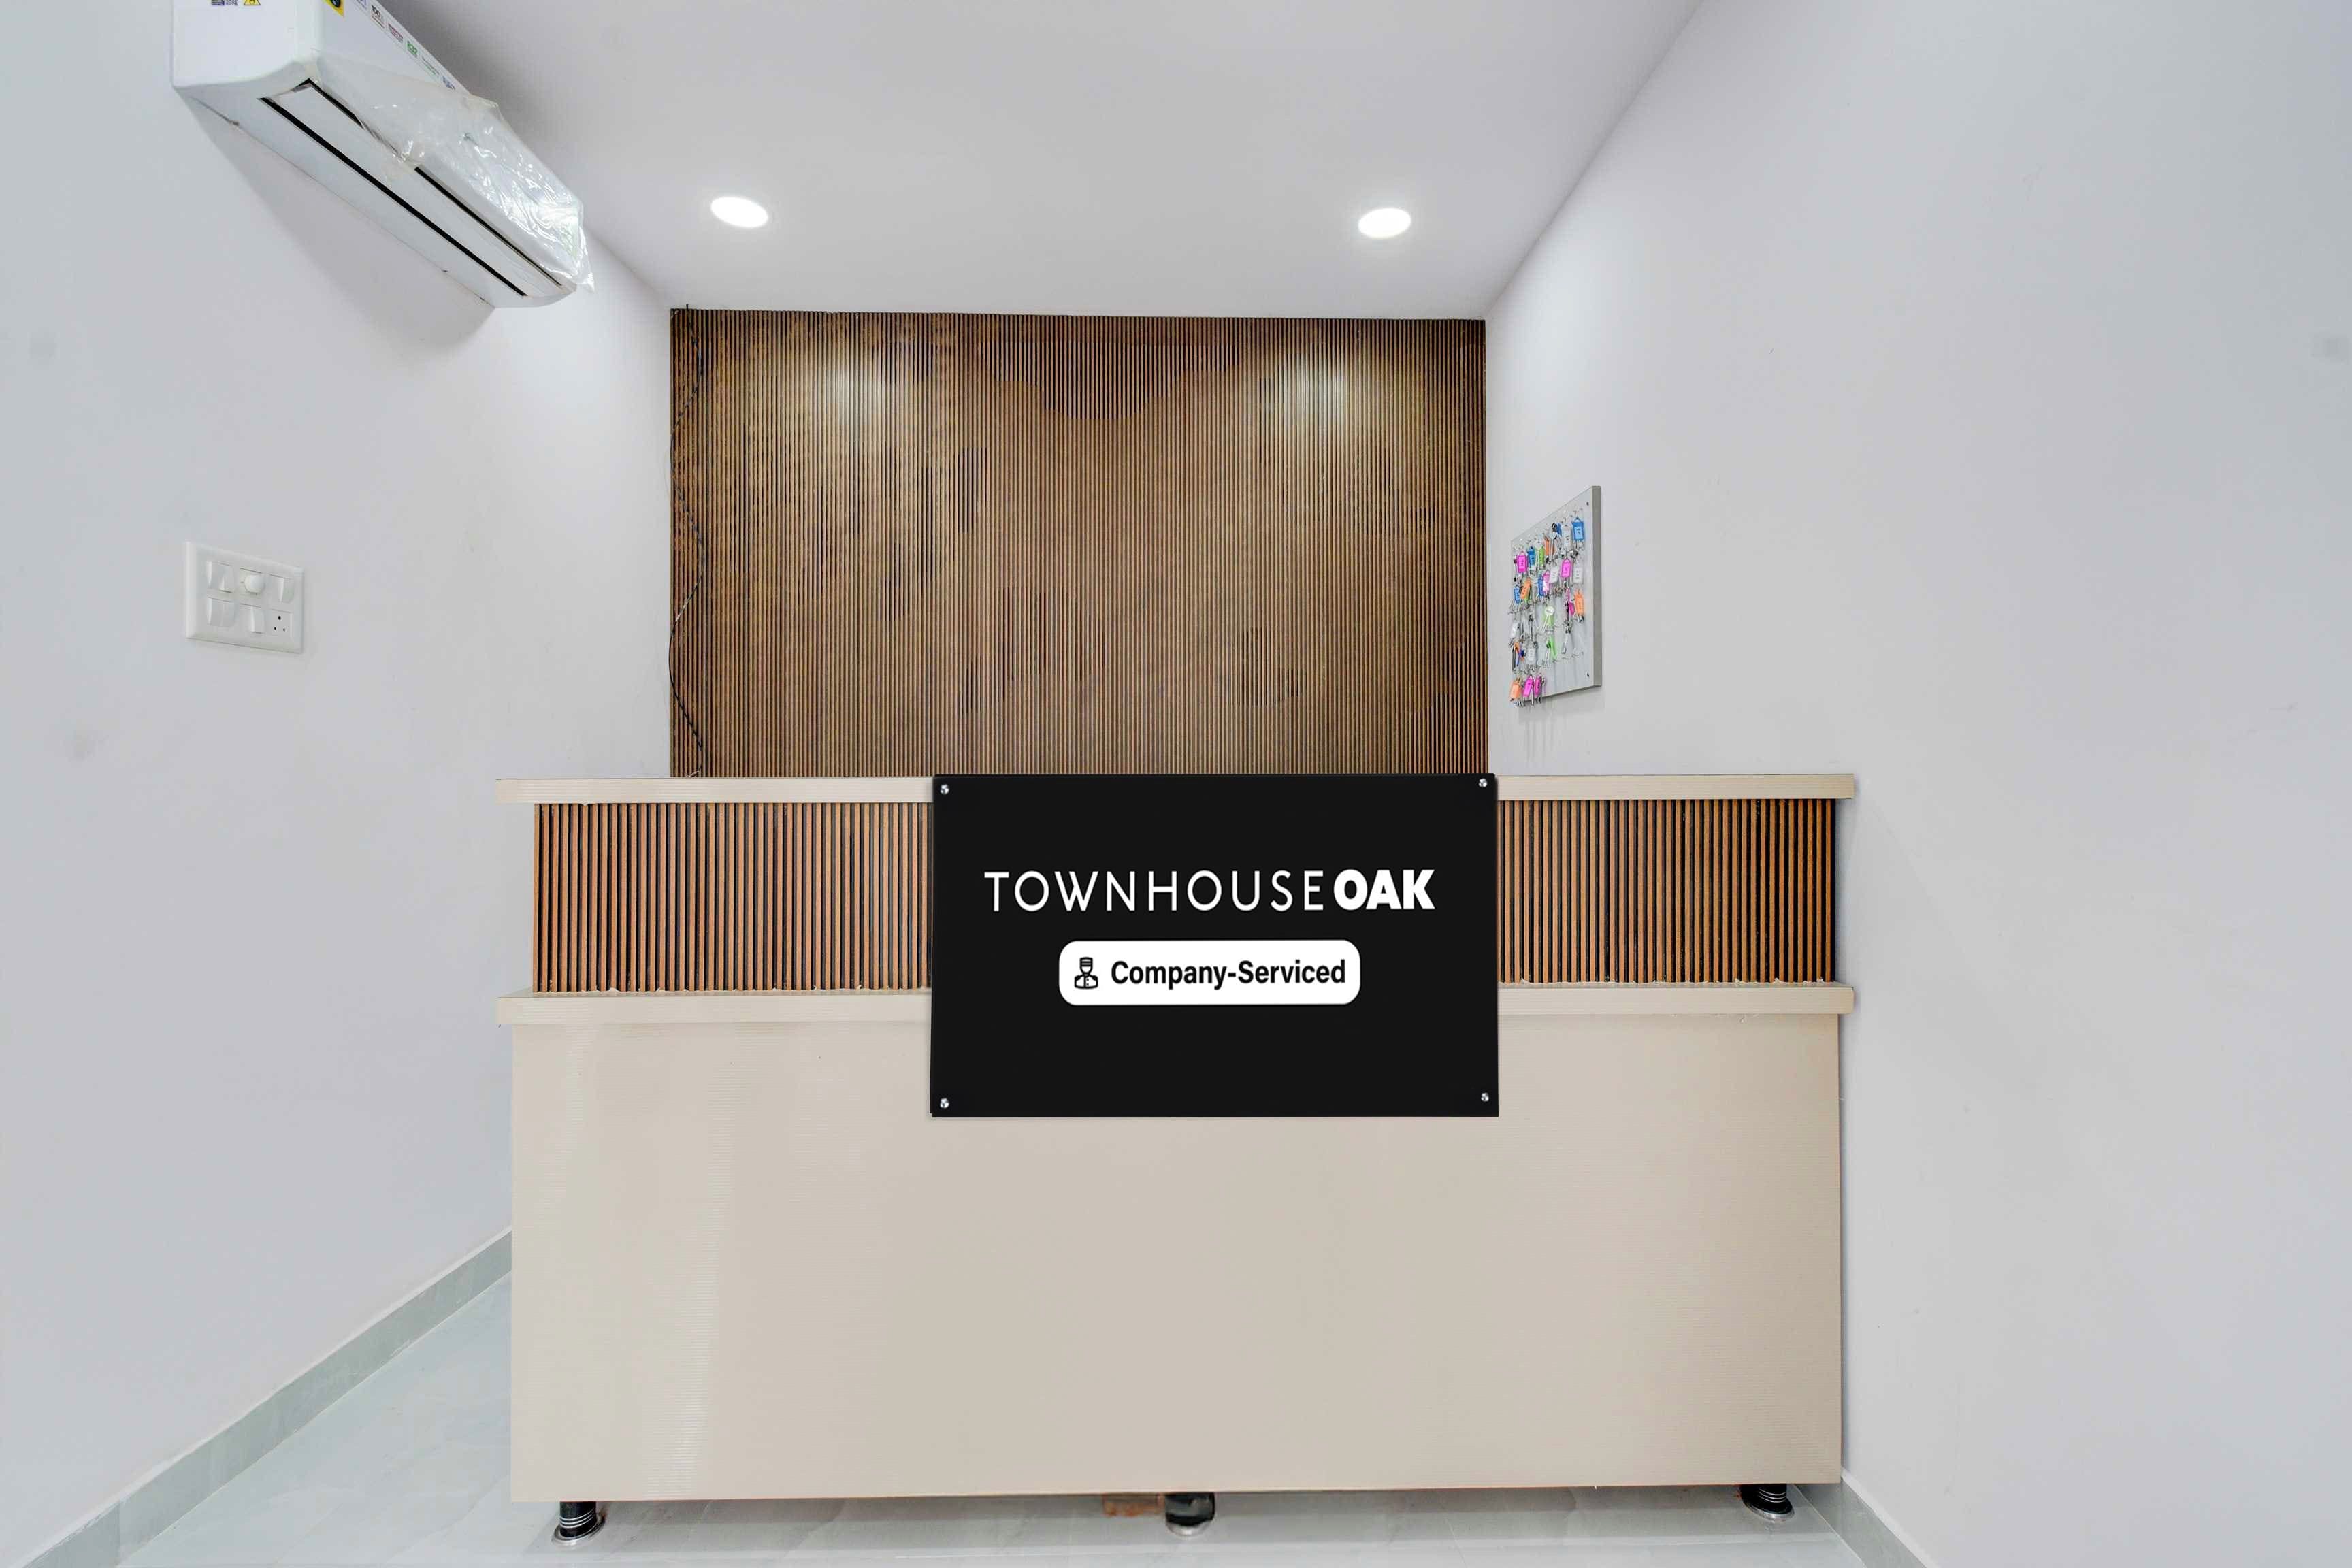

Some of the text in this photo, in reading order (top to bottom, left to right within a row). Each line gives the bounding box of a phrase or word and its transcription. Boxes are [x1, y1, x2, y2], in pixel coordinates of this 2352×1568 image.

[984, 869, 1435, 912] TOWNHOUSE OAK
[1111, 959, 1345, 990] Company-Serviced
